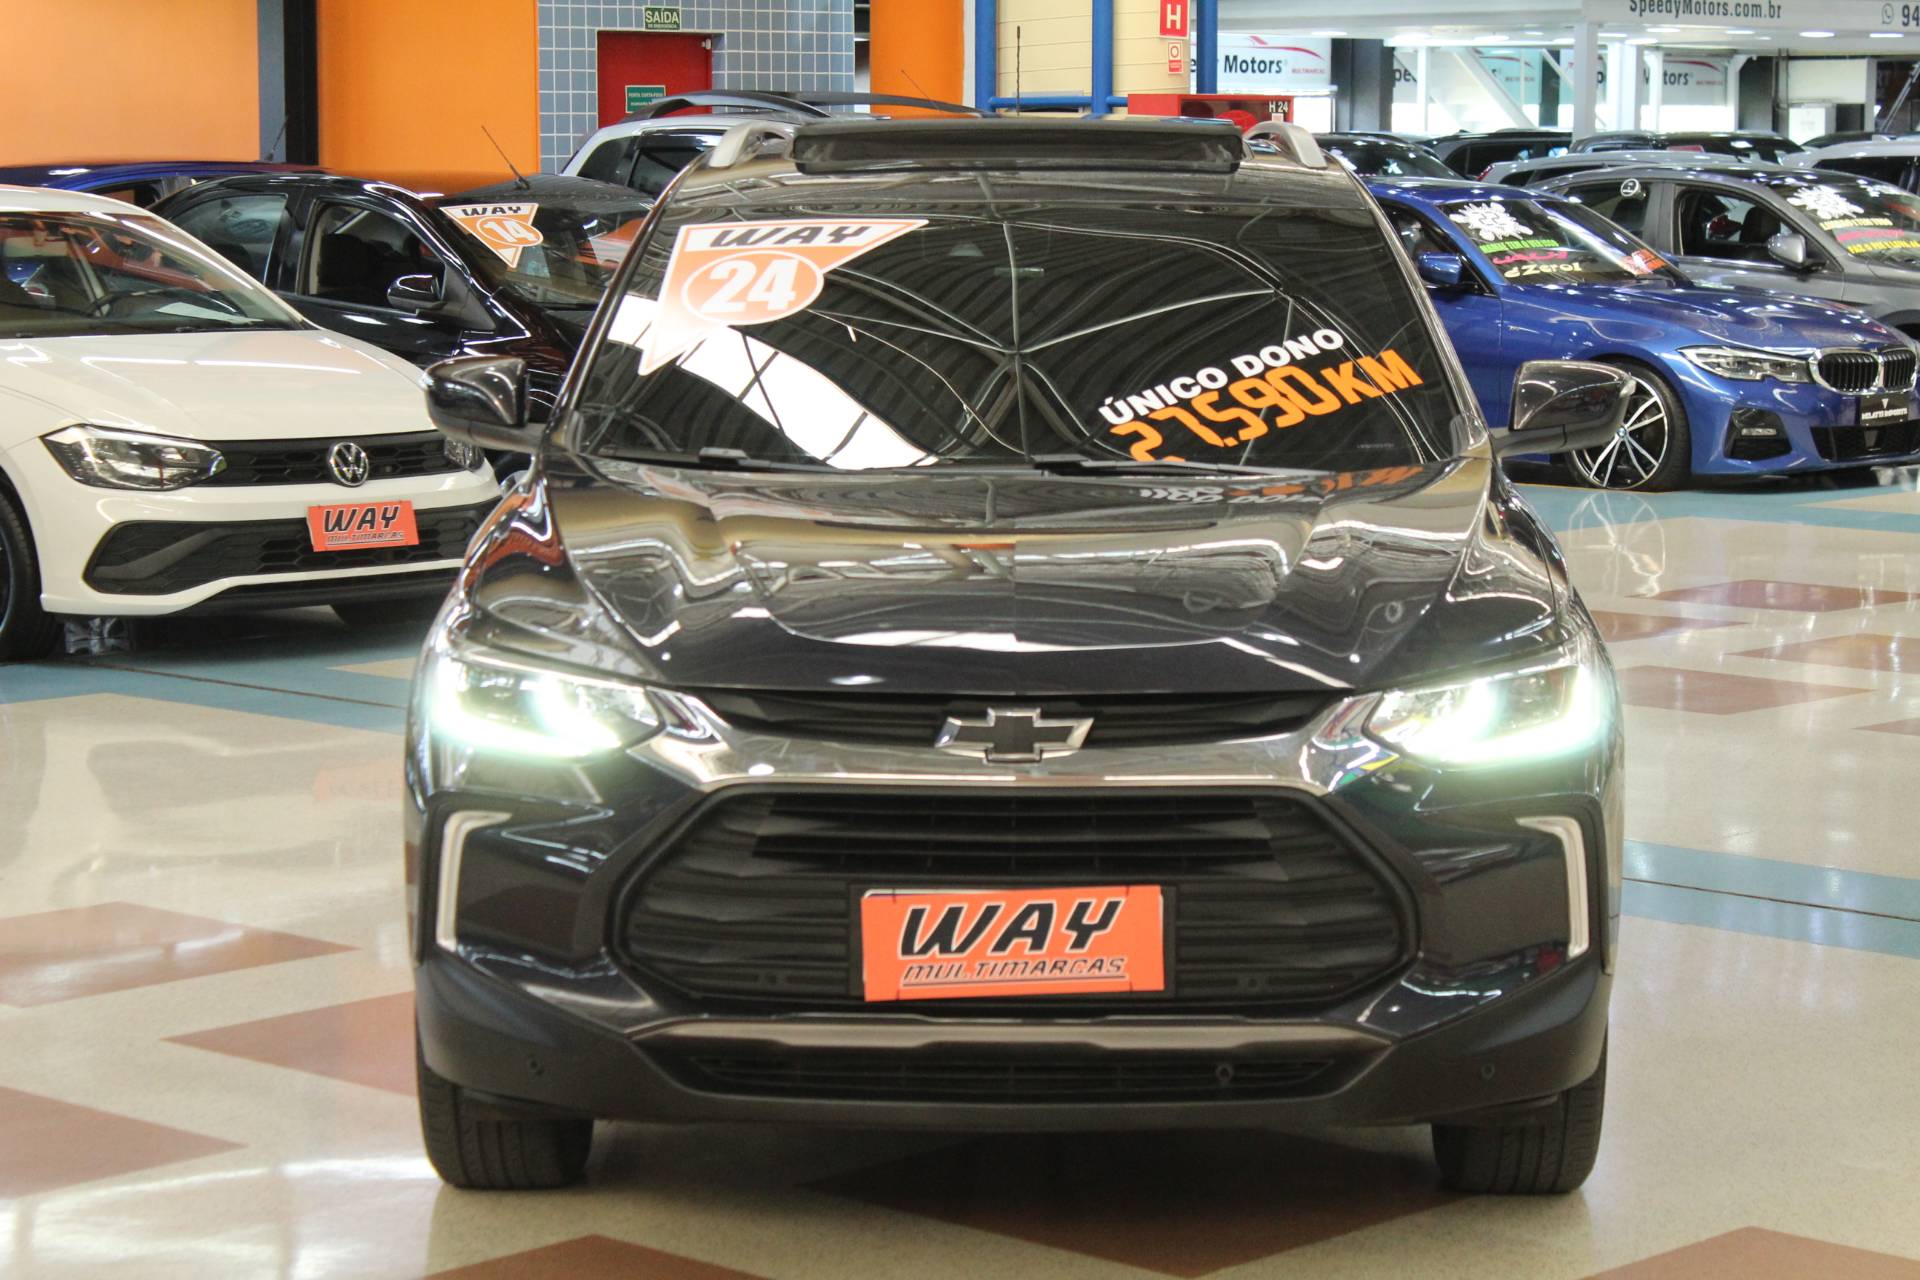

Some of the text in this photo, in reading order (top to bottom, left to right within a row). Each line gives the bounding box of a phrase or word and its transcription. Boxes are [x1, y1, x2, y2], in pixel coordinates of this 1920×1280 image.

[645, 8, 680, 23] SAÍDA
[1166, 4, 1182, 30] H
[1223, 54, 1283, 74] Motors
[1268, 101, 1289, 113] H 24
[461, 206, 522, 217] WAY
[483, 220, 539, 243] 14
[709, 226, 872, 248] WAY
[701, 257, 800, 315] 24
[1098, 328, 1345, 426] ÚNICO DONO
[324, 506, 400, 533] WAY
[899, 897, 1127, 960] WAY
[902, 956, 1128, 983] MULTIMARCAS
